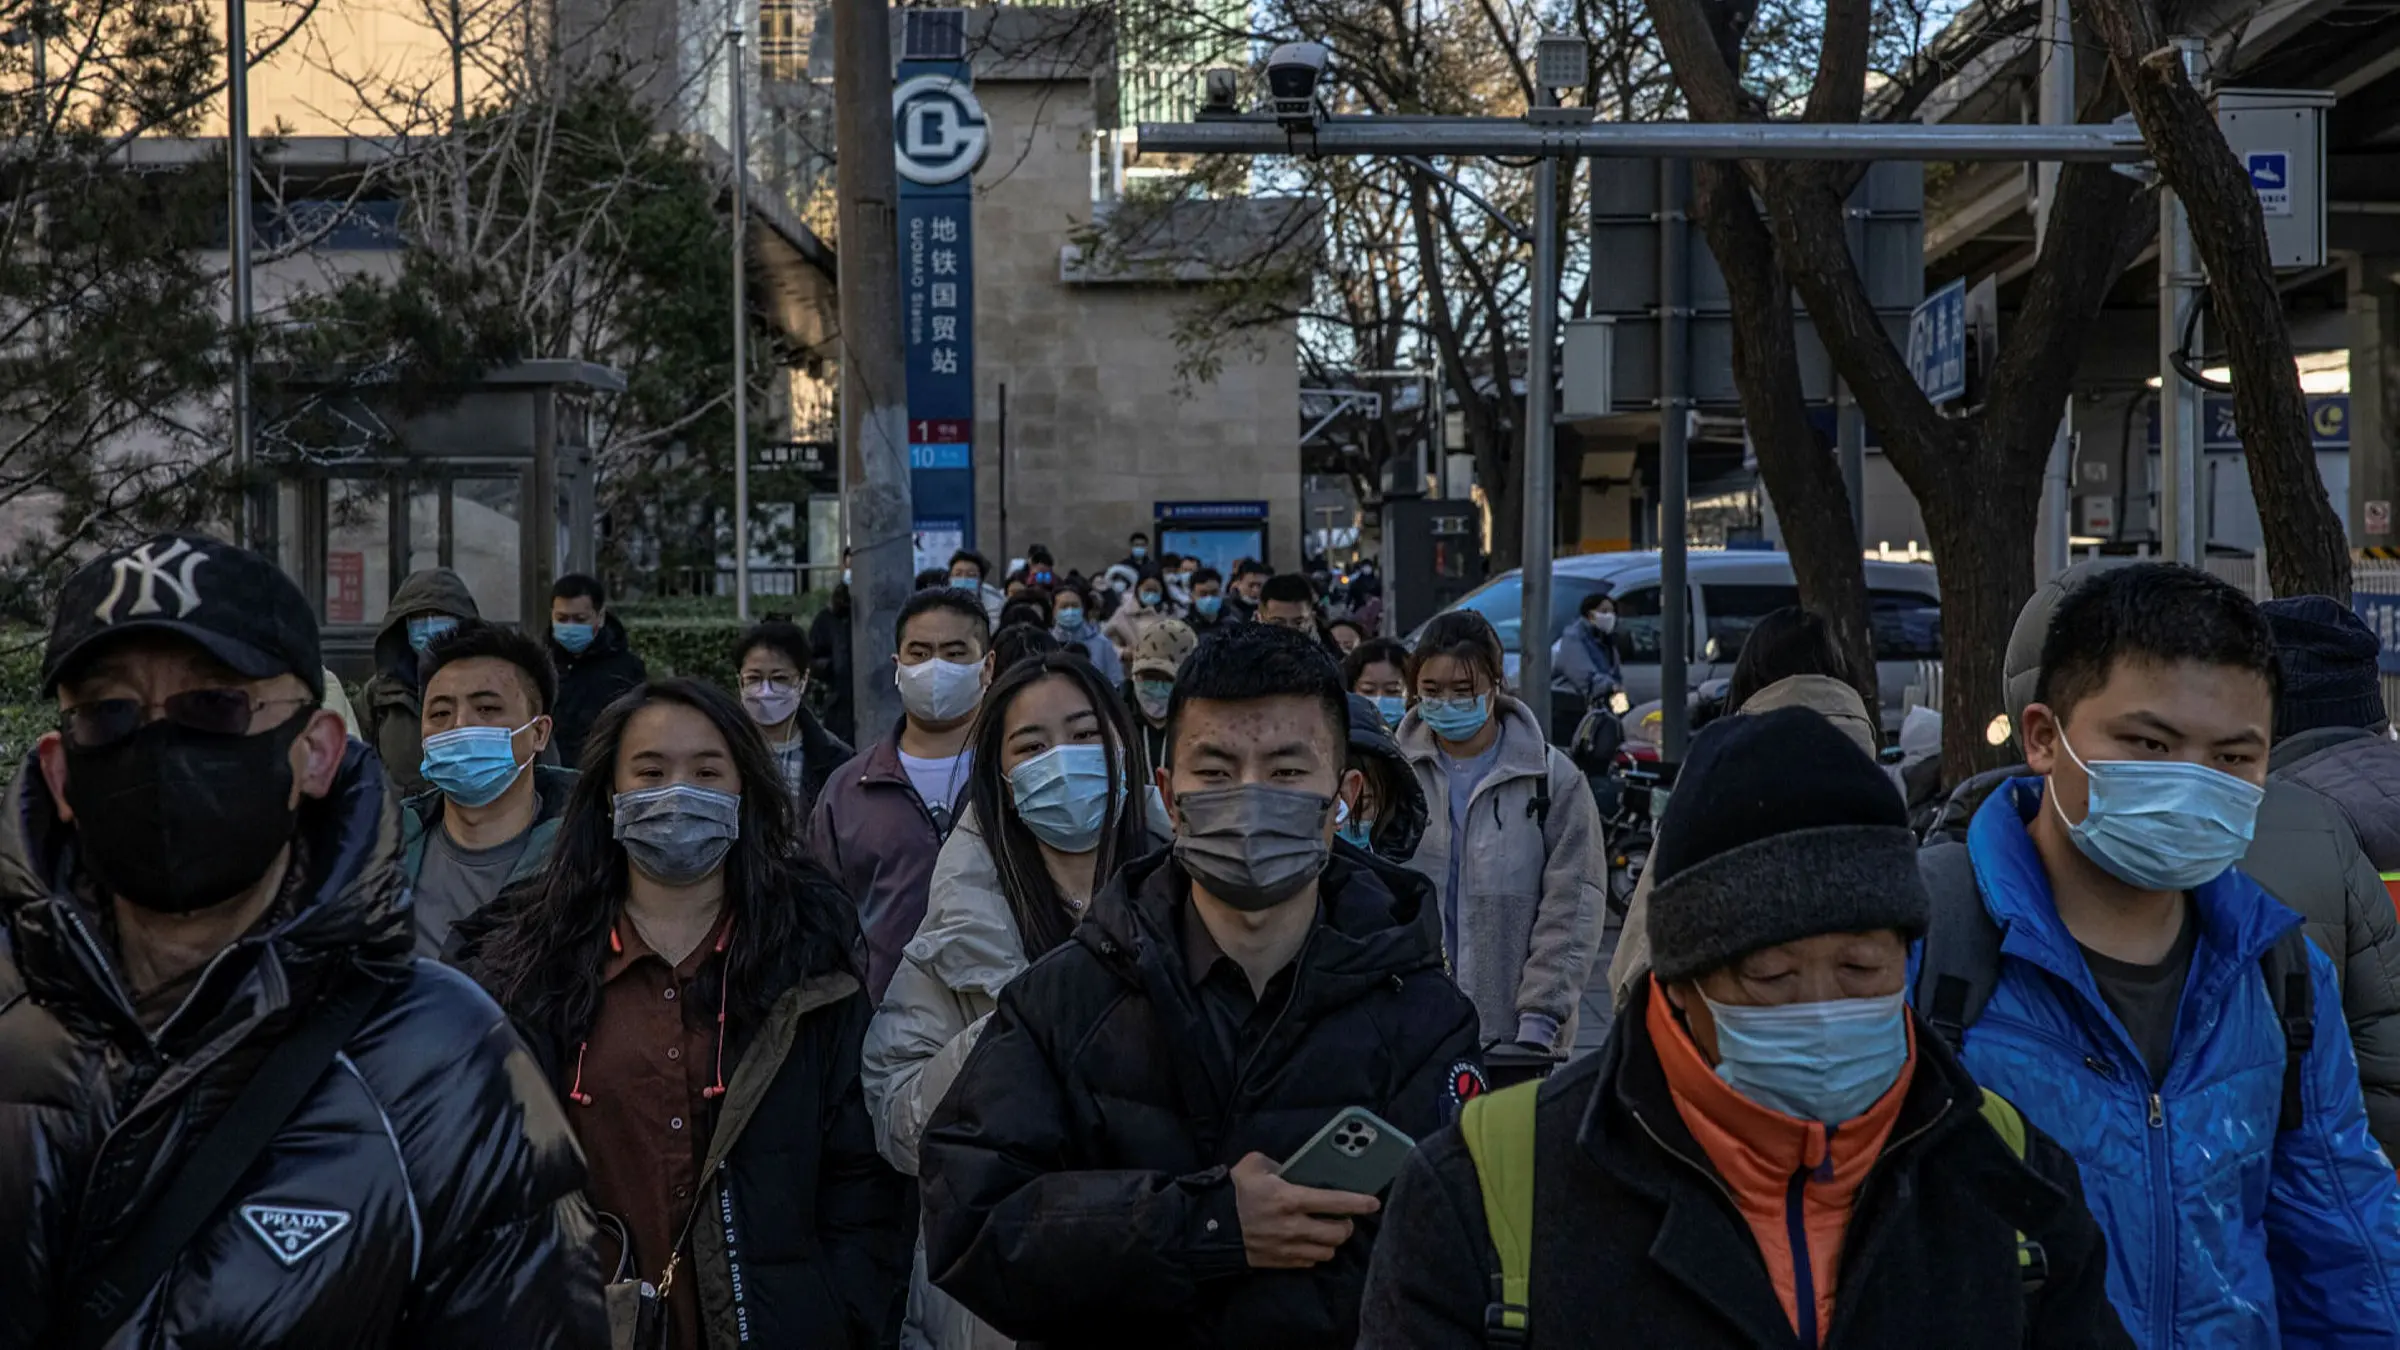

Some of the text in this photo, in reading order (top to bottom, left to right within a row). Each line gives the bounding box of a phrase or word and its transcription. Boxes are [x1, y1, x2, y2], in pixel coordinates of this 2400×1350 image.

[910, 217, 925, 287] GUOMAO
[931, 216, 958, 374] 地铁国贸站
[917, 420, 929, 442] 1
[911, 446, 935, 468] 10
[94, 537, 210, 626] NY
[262, 1211, 328, 1230] PRADA
